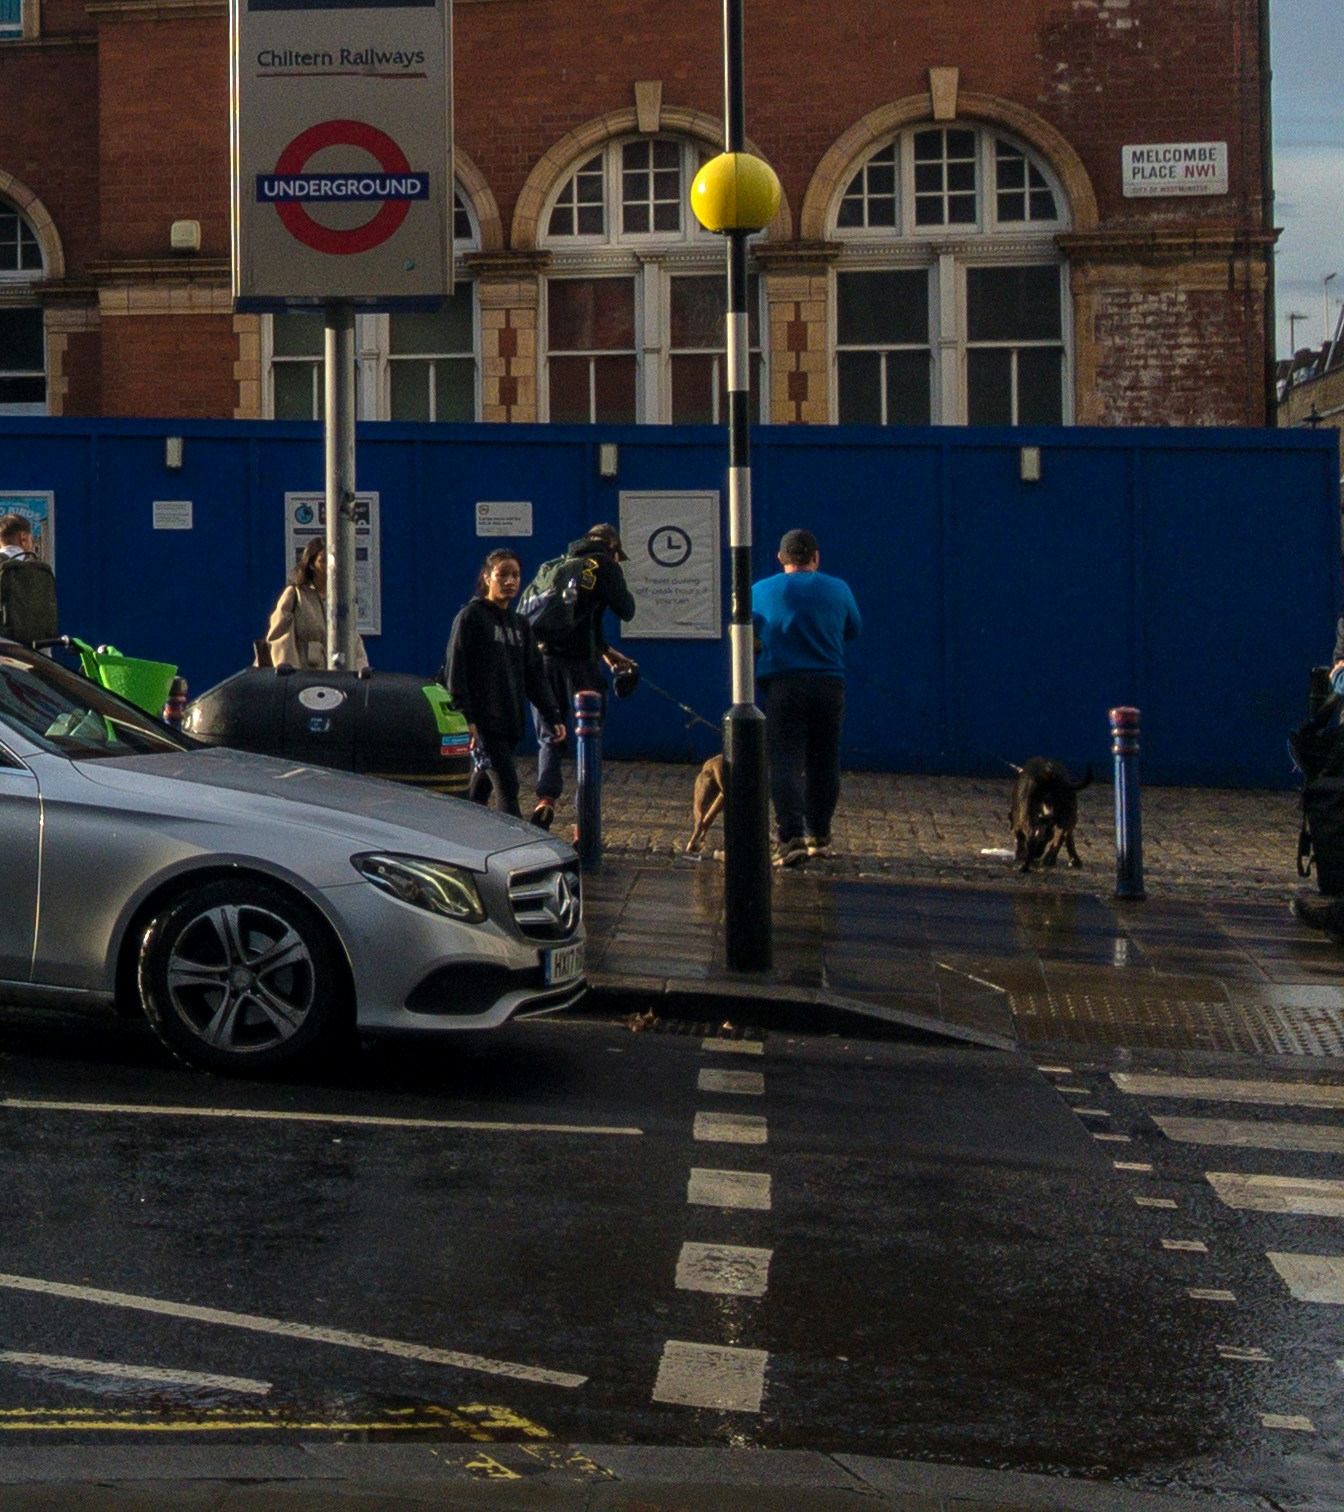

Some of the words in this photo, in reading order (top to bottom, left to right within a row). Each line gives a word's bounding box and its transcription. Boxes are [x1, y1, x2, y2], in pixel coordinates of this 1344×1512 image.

[257, 48, 333, 68] Chiltern
[339, 46, 425, 69] Railways
[1132, 147, 1217, 164] MELCOMBE
[1132, 165, 1176, 180] PLACE
[1185, 163, 1216, 178] NW1
[264, 178, 421, 197] UNDERGROUND
